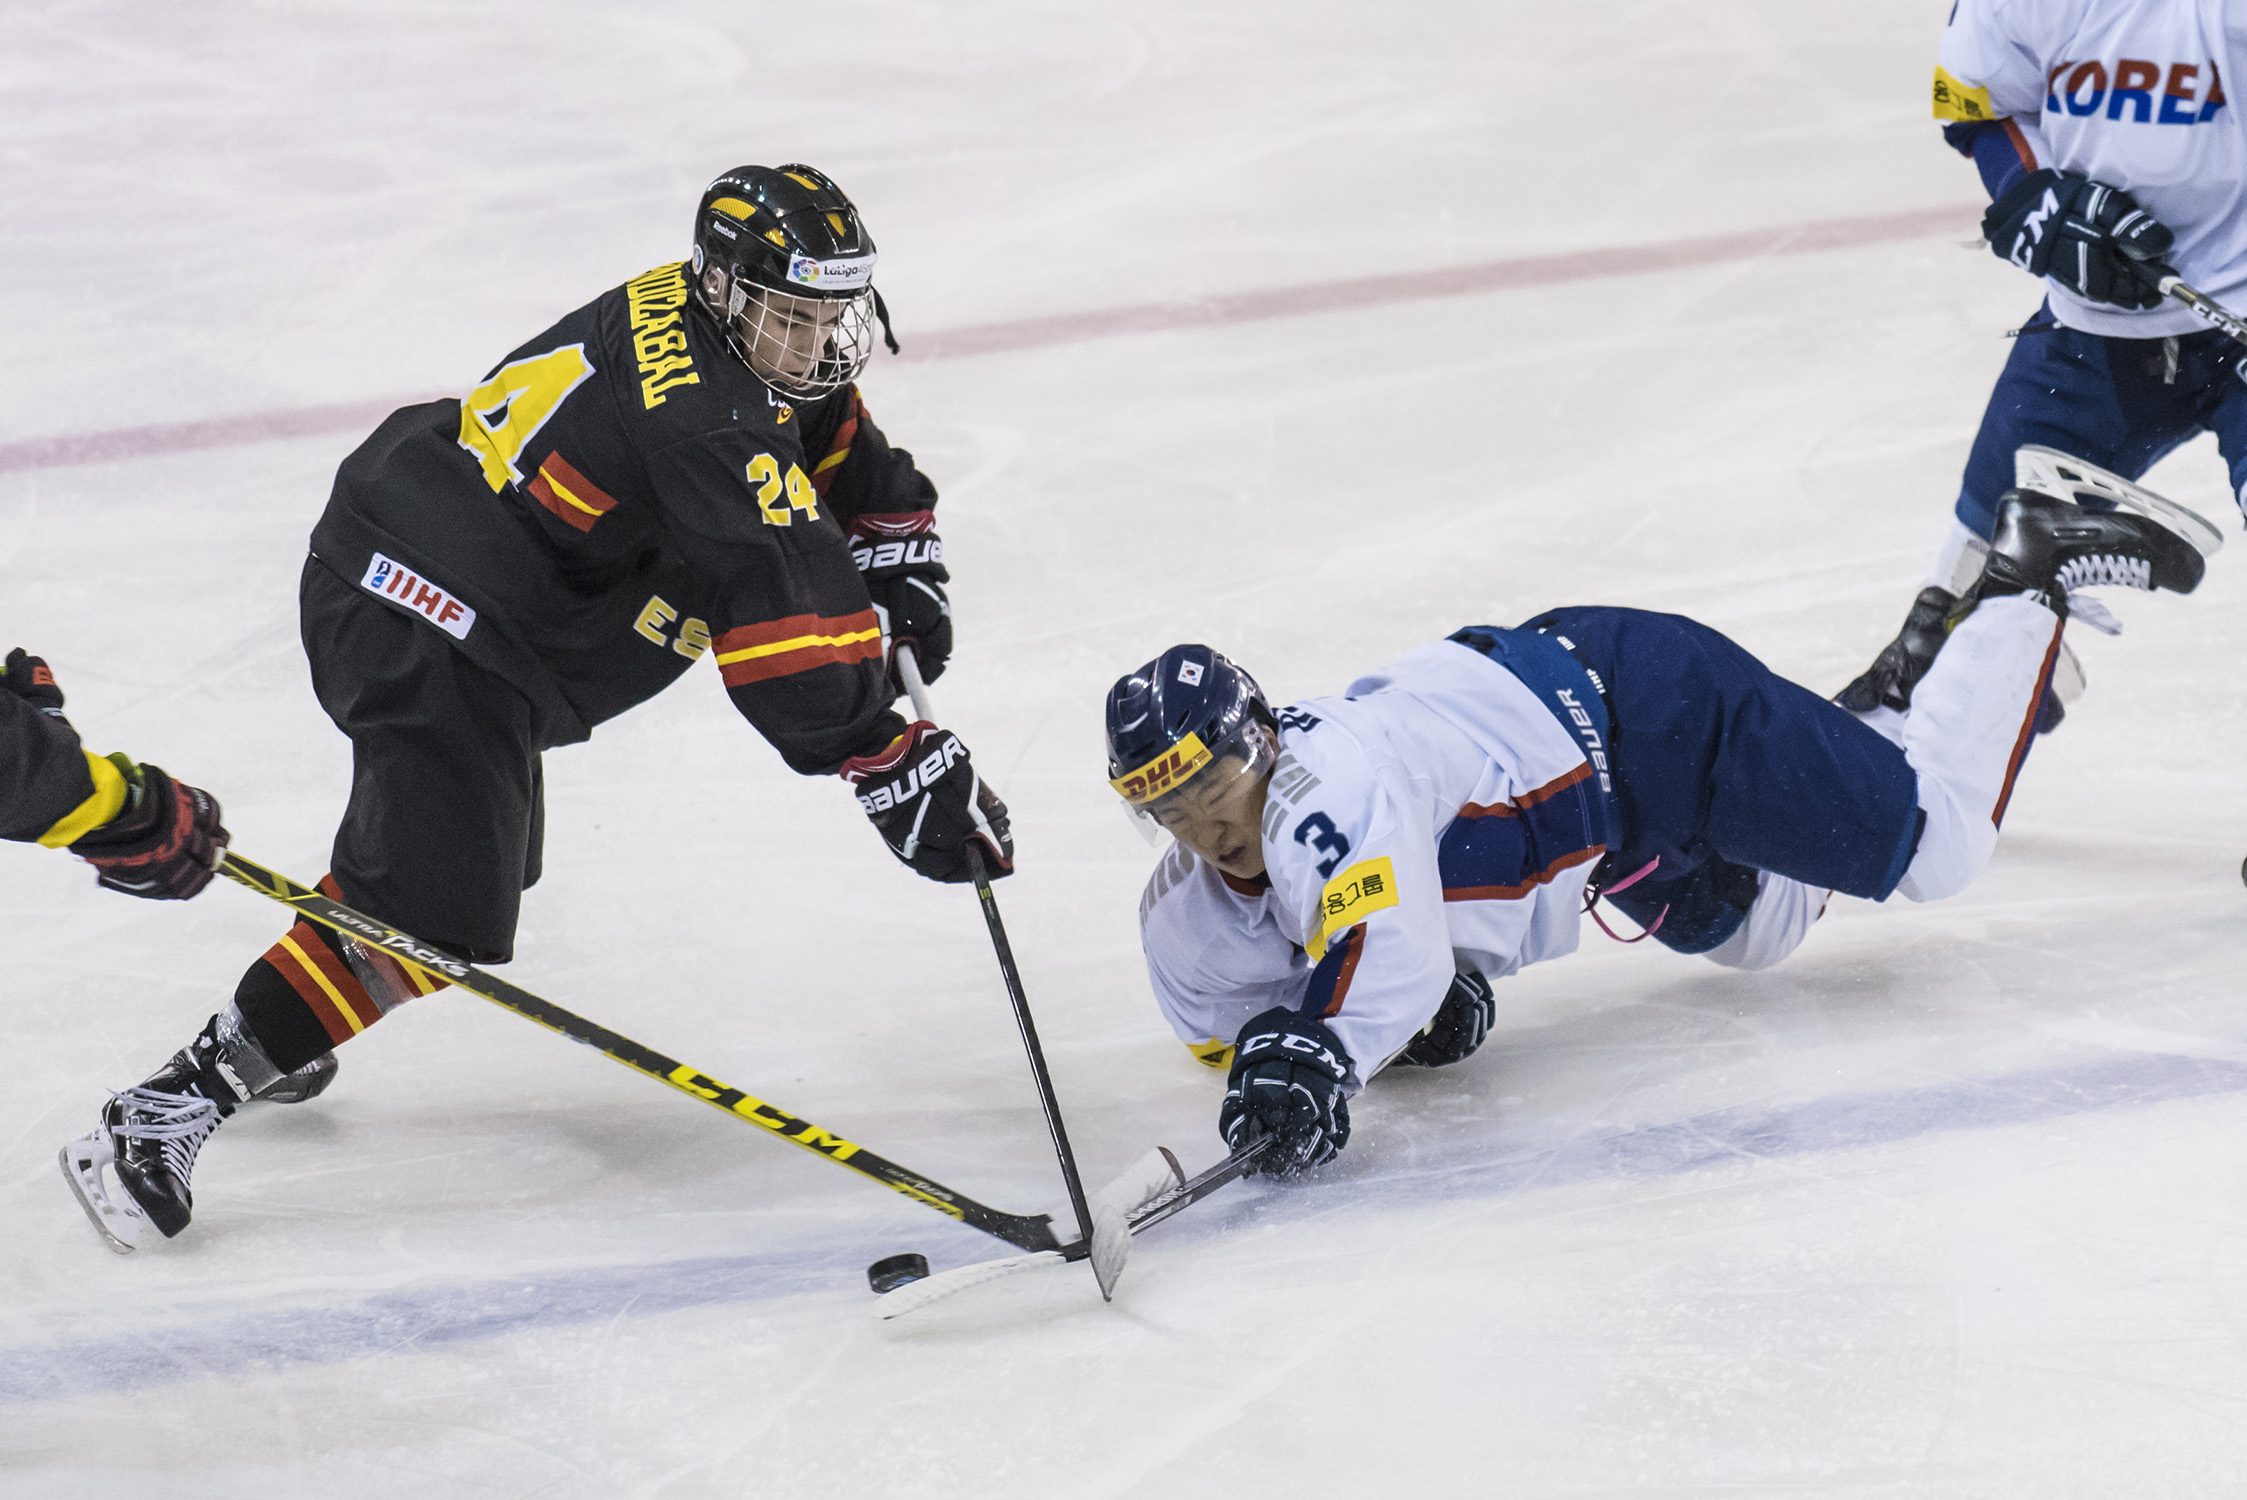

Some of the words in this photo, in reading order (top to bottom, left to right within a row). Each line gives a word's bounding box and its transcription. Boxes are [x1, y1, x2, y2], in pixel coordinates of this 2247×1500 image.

[713, 220, 738, 242] Reebok
[2010, 187, 2060, 273] CM
[2193, 301, 2241, 338] CCM
[745, 452, 820, 526] 24
[386, 569, 465, 623] IIHF
[632, 594, 712, 661] ES
[1556, 688, 1612, 793] BAUER
[857, 735, 967, 815] BAUER
[1121, 751, 1194, 799] DHL
[1294, 811, 1350, 880] 3
[327, 910, 384, 938] ULTRA
[380, 932, 470, 977] TACKS
[1241, 1032, 1347, 1079] CCM
[668, 1064, 862, 1161] CCM
